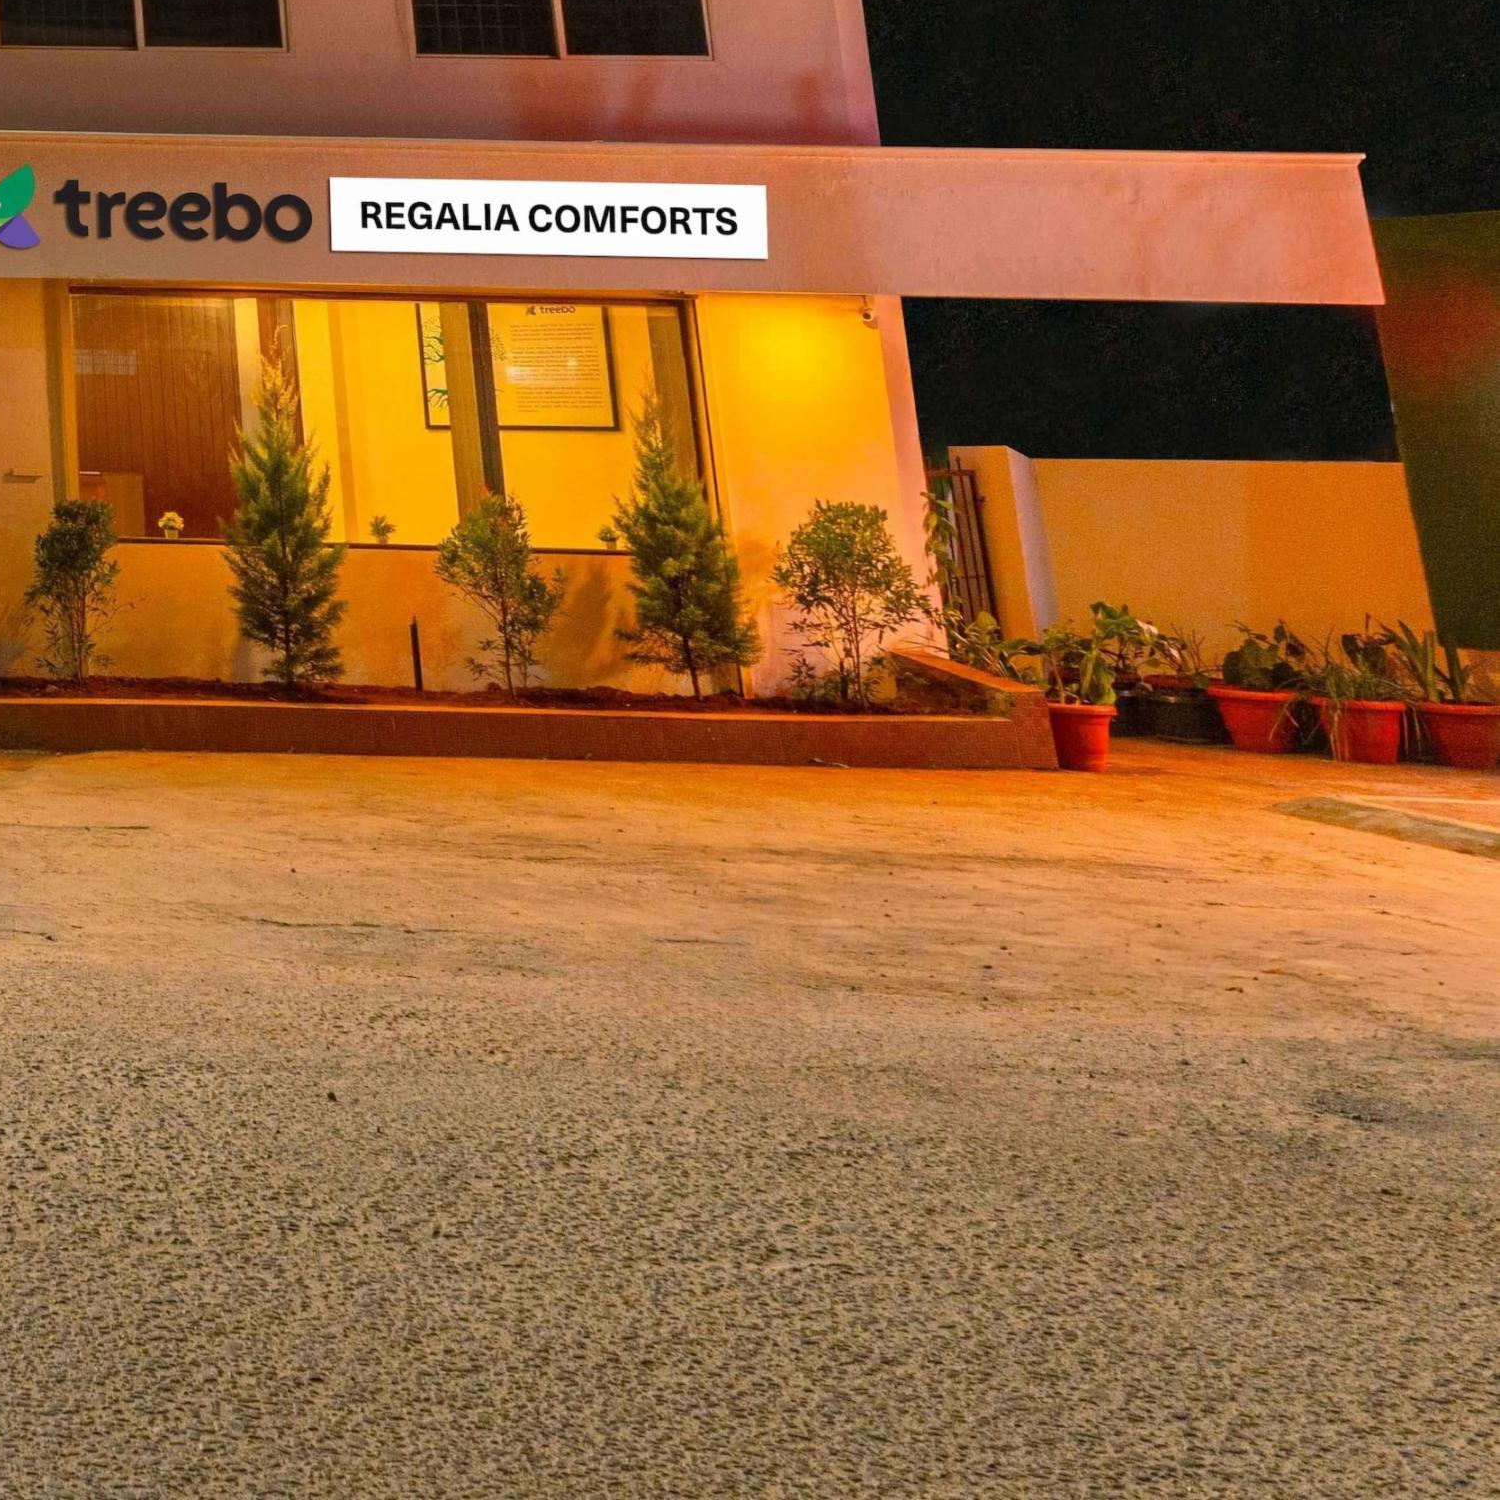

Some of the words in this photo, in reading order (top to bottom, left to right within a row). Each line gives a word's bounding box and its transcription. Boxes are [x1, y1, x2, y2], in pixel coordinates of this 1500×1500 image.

[54, 180, 313, 242] treebo
[361, 201, 520, 232] REGALIA
[529, 204, 738, 236] COMFORTS
